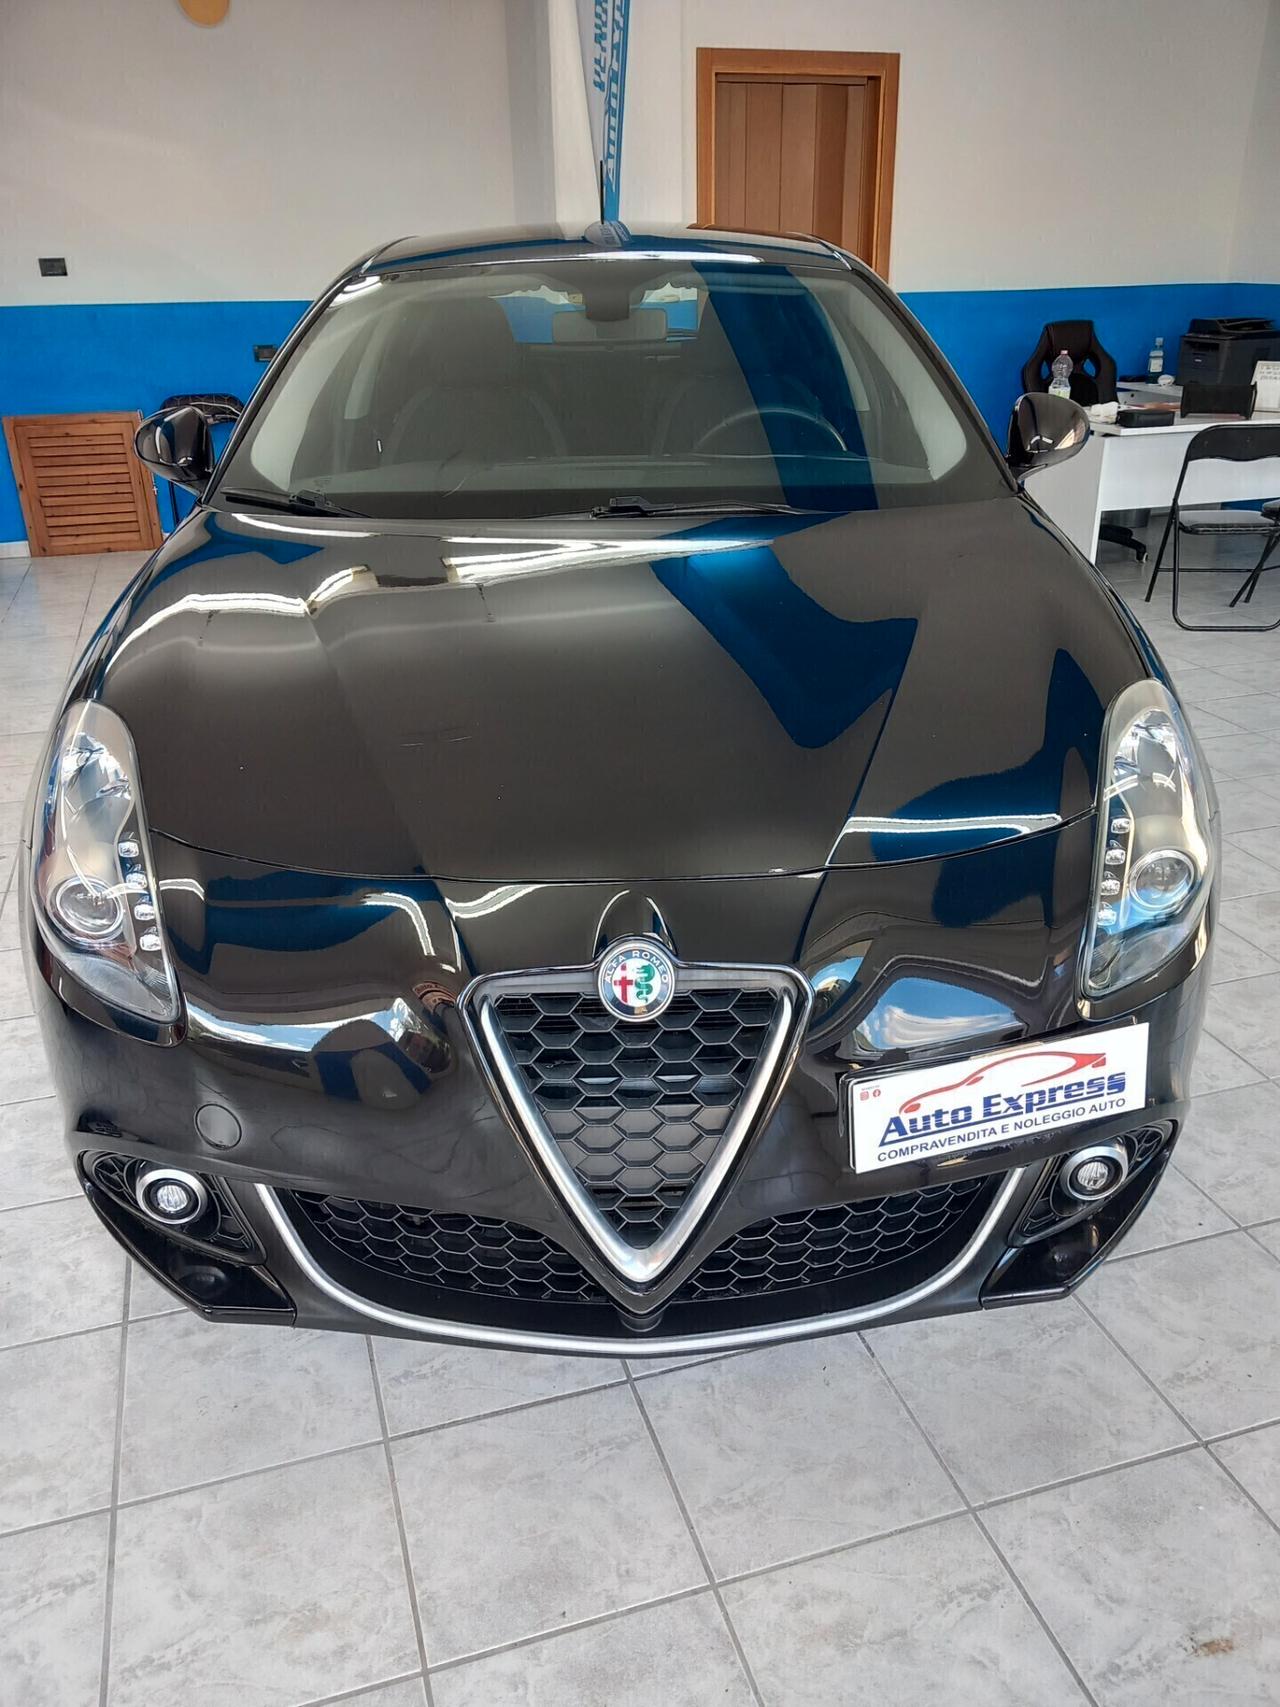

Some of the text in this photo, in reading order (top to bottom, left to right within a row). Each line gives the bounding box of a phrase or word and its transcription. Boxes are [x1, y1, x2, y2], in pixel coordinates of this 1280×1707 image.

[604, 950, 669, 984] ALFA ROMEO
[877, 1098, 1126, 1162] COMPRAVENDITA E NOLEGGIO AUTO
[879, 1072, 1126, 1147] Auto Express
